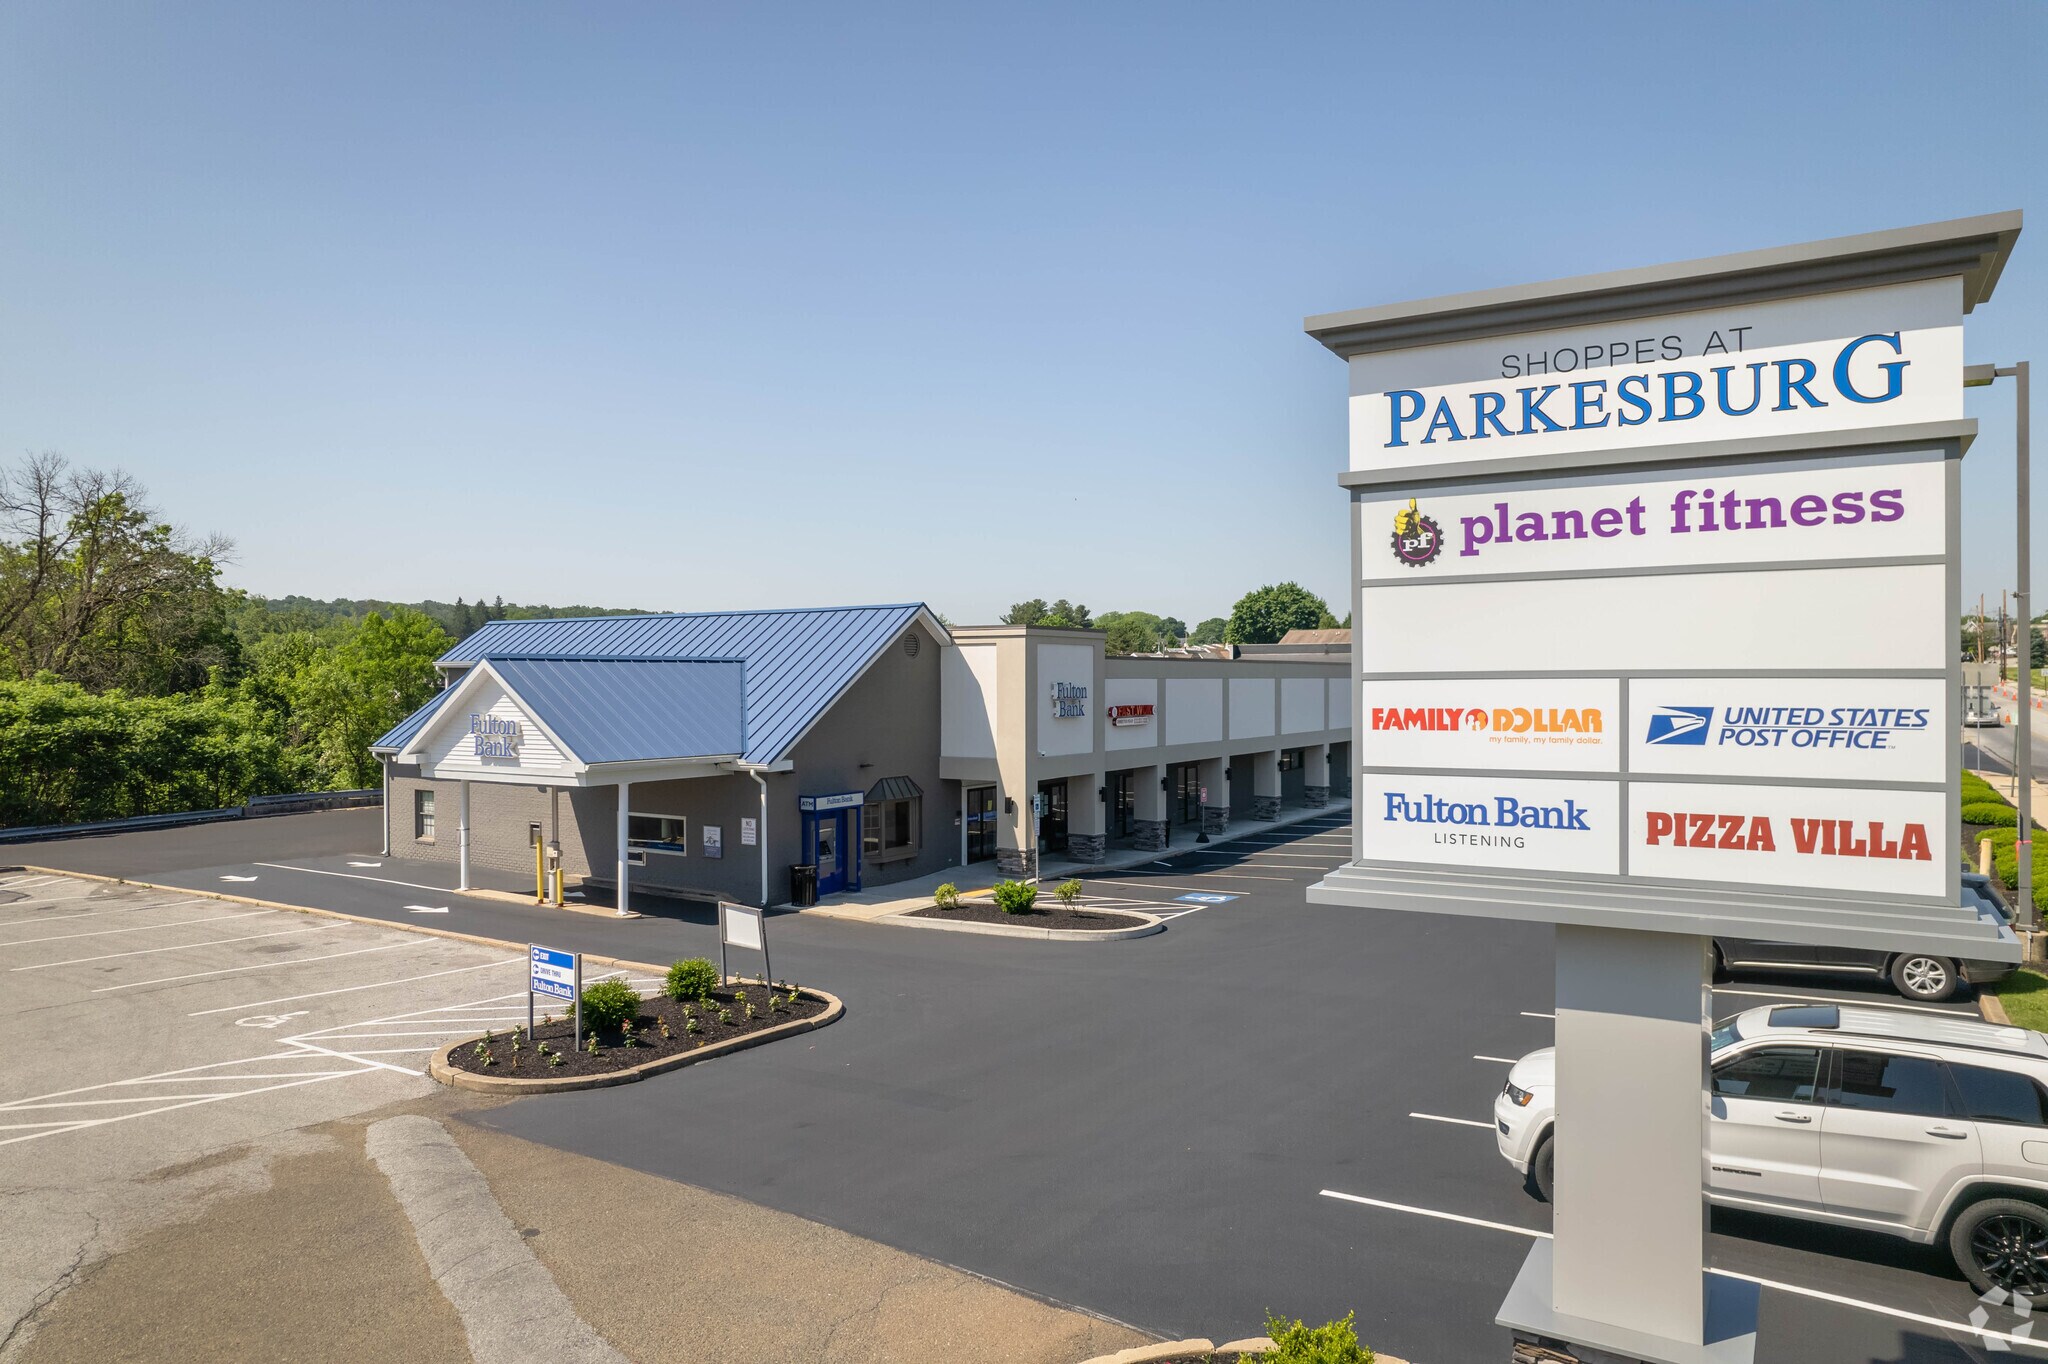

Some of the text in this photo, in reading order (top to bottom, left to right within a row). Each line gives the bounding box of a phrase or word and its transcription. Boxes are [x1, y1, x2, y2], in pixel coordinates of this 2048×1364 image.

[1501, 326, 1753, 379] SHOPPES AT
[1383, 331, 1911, 448] PARKESBURG
[1460, 489, 1905, 557] planet fitness
[1402, 532, 1433, 551] pf
[1056, 682, 1088, 699] Fulton
[1059, 700, 1086, 717] Bank
[1724, 707, 1930, 728] UNITED STATES
[469, 714, 517, 735] Fulton
[1371, 707, 1603, 733] FAMILY DOLLAR
[474, 735, 513, 758] Bank
[1489, 735, 1502, 744] my
[1503, 735, 1531, 745] family,
[1533, 736, 1547, 745] my
[1548, 736, 1574, 746] family
[1718, 728, 1789, 747] POST
[1791, 730, 1890, 749] OFFICE
[1384, 792, 1591, 831] Fulton Bank
[1434, 833, 1526, 849] LISTENING
[1646, 811, 1933, 861] PIZZA VILLA
[533, 979, 573, 998] Fulton Bank
